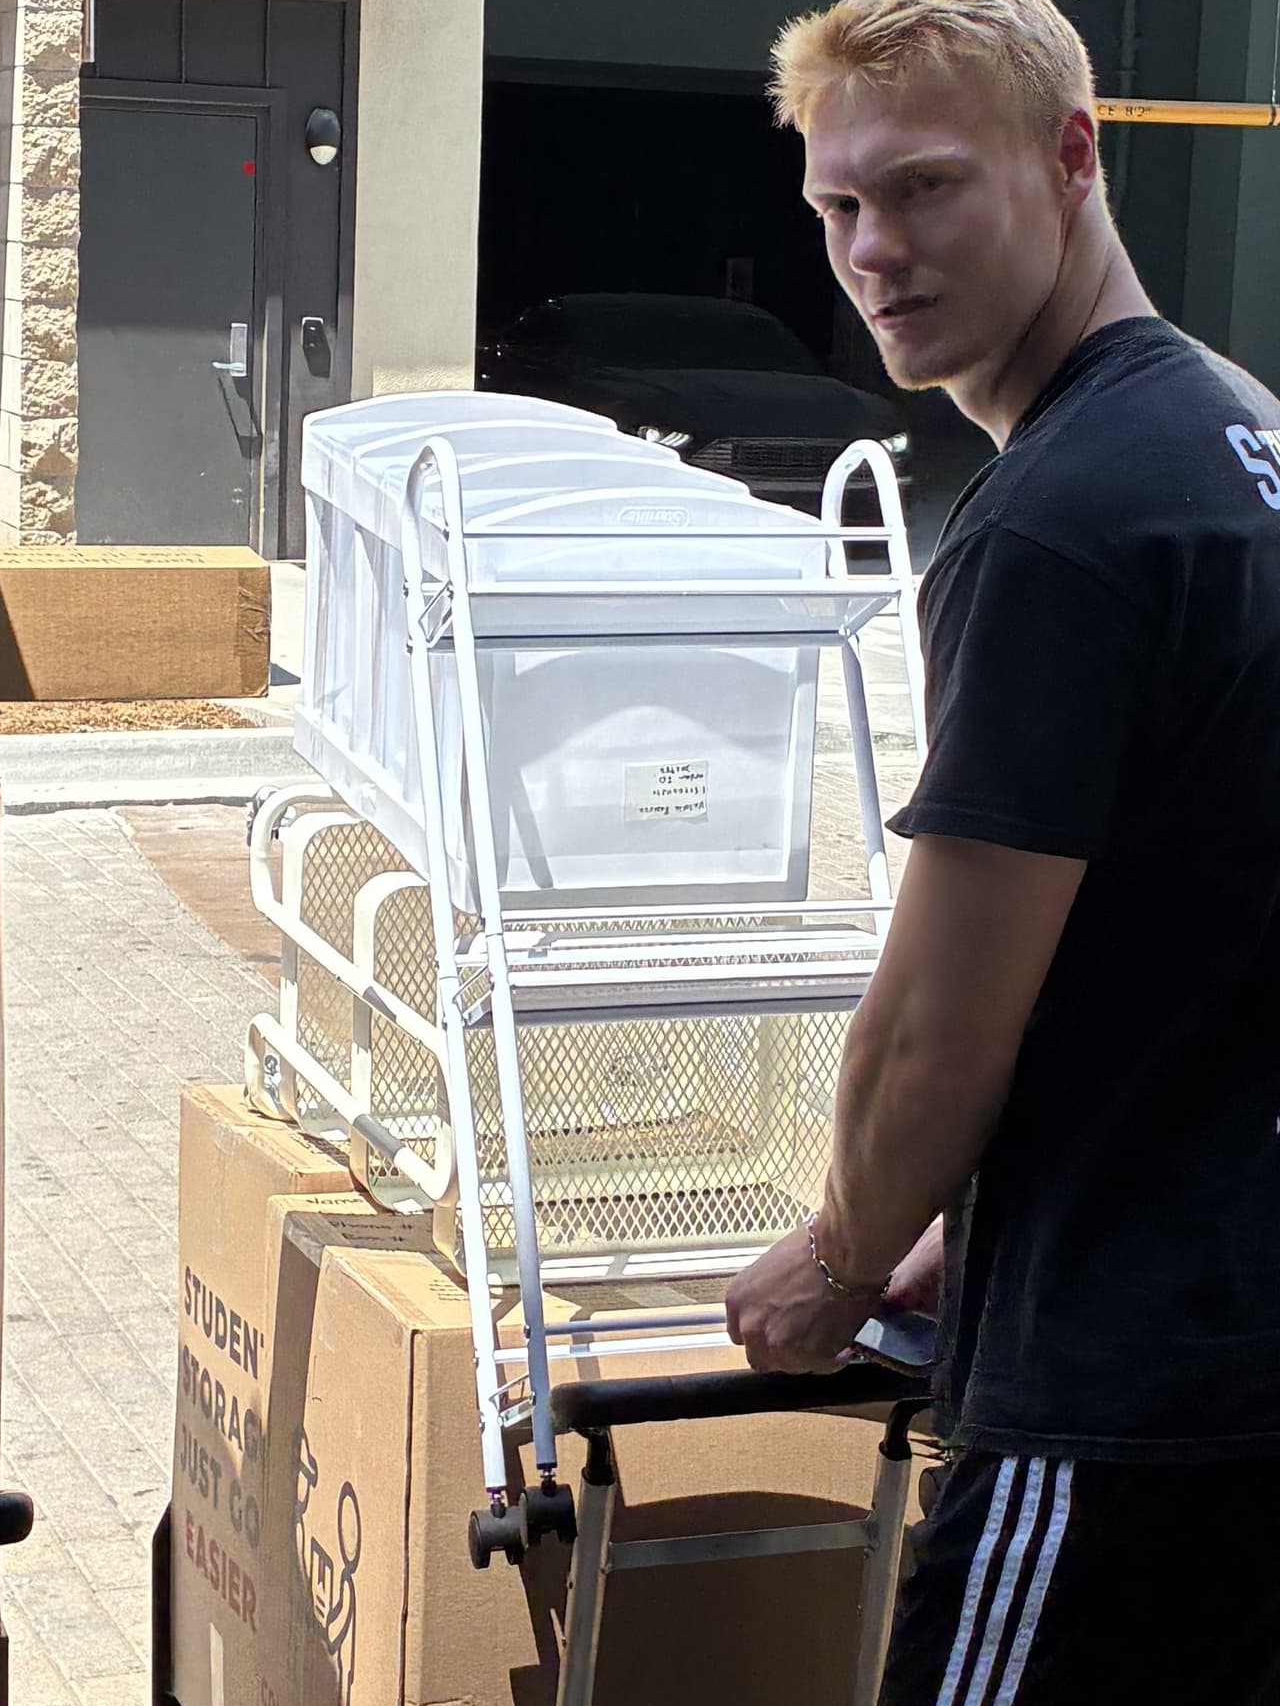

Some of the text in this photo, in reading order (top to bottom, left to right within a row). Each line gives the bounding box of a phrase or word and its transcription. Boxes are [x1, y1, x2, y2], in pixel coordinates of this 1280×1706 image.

[185, 1266, 264, 1380] STUDEN
[183, 1345, 263, 1464] STORAG
[180, 1424, 222, 1510] JUST
[186, 1509, 257, 1634] EASIER
